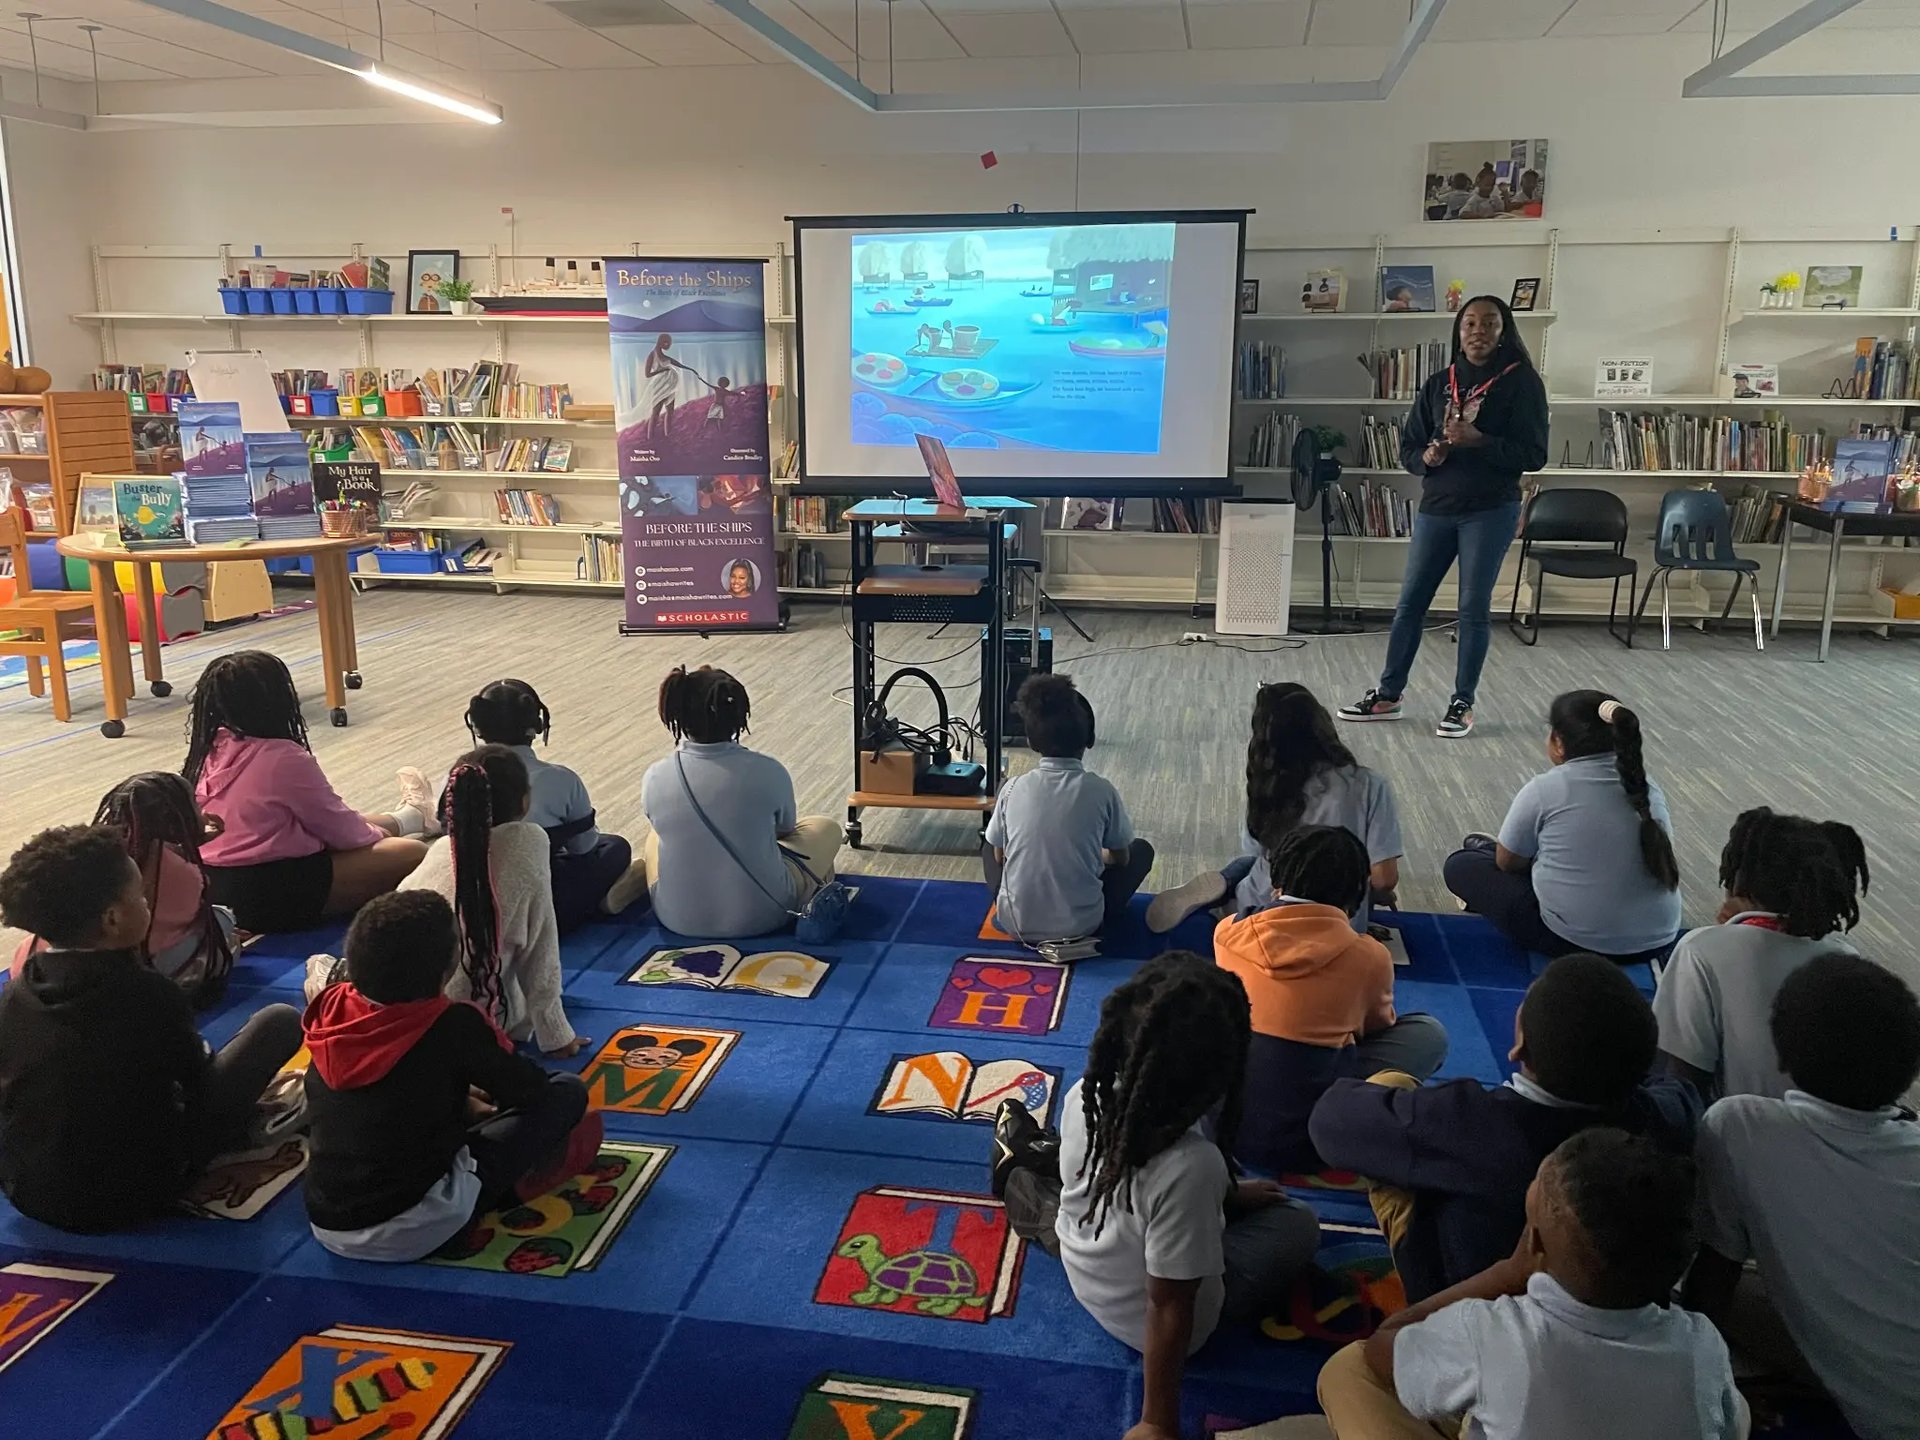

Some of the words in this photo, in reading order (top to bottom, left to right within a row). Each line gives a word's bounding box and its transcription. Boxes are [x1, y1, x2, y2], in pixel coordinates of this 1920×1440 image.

[617, 268, 674, 286] Before
[679, 272, 702, 287] the
[706, 270, 752, 293] Ships
[328, 466, 346, 477] My
[348, 466, 373, 475] Hair
[123, 483, 163, 495] Buster
[343, 478, 379, 492] Book
[141, 492, 172, 506] Bully
[646, 523, 693, 535] BEFORE
[693, 522, 717, 534] THE
[719, 522, 753, 533] SHIPS
[650, 539, 674, 547] BIRTH
[674, 539, 687, 547] OF
[687, 538, 715, 546] BLACK
[715, 537, 765, 546] EXCELLENCE
[668, 612, 748, 622] SCHOLASTIC
[733, 952, 816, 990] G
[945, 990, 1037, 1029] H
[585, 1062, 692, 1110] M
[879, 1051, 969, 1111] N
[902, 1201, 994, 1254] T
[242, 1344, 395, 1421] X
